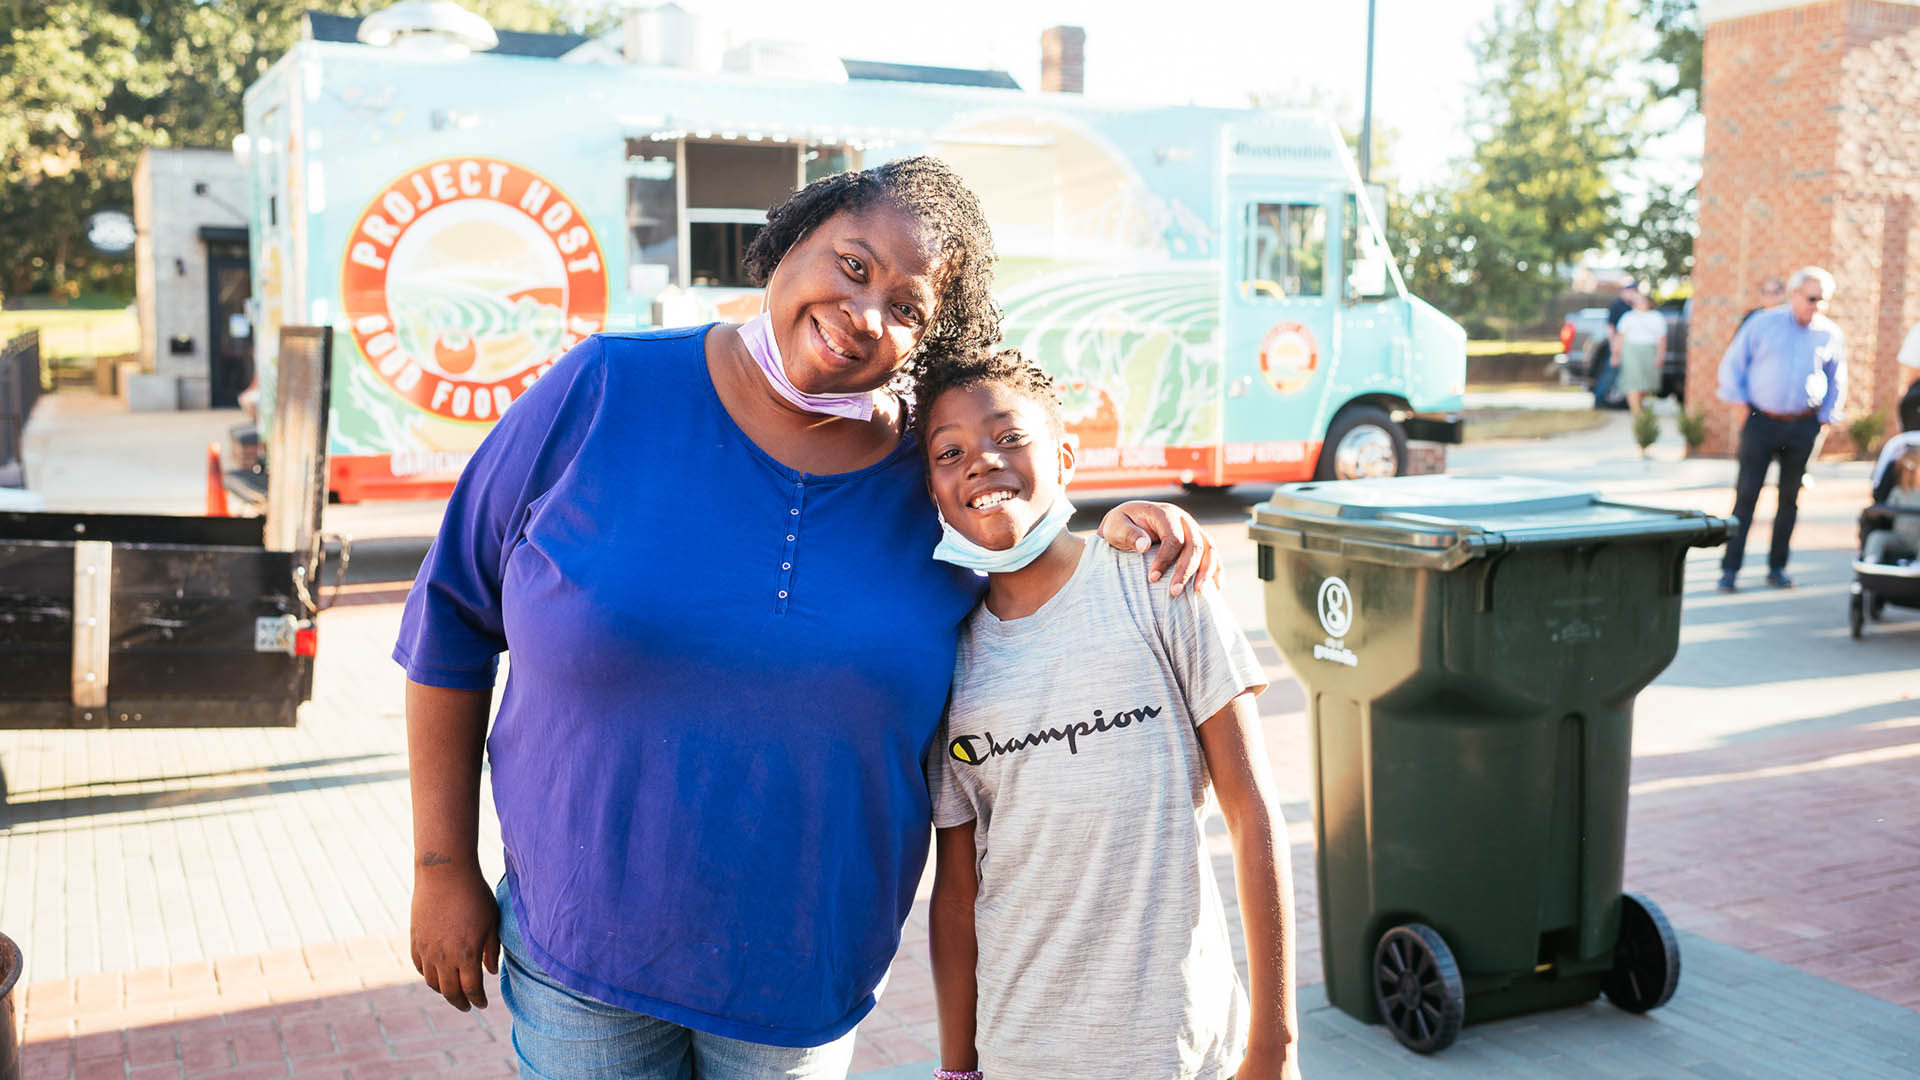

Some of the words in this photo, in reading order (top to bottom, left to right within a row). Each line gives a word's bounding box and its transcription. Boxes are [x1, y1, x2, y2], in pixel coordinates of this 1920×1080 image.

[351, 161, 509, 271] PROJECT
[520, 179, 600, 273] HOST
[431, 381, 513, 419] FOOD
[950, 705, 1162, 765] Champion
